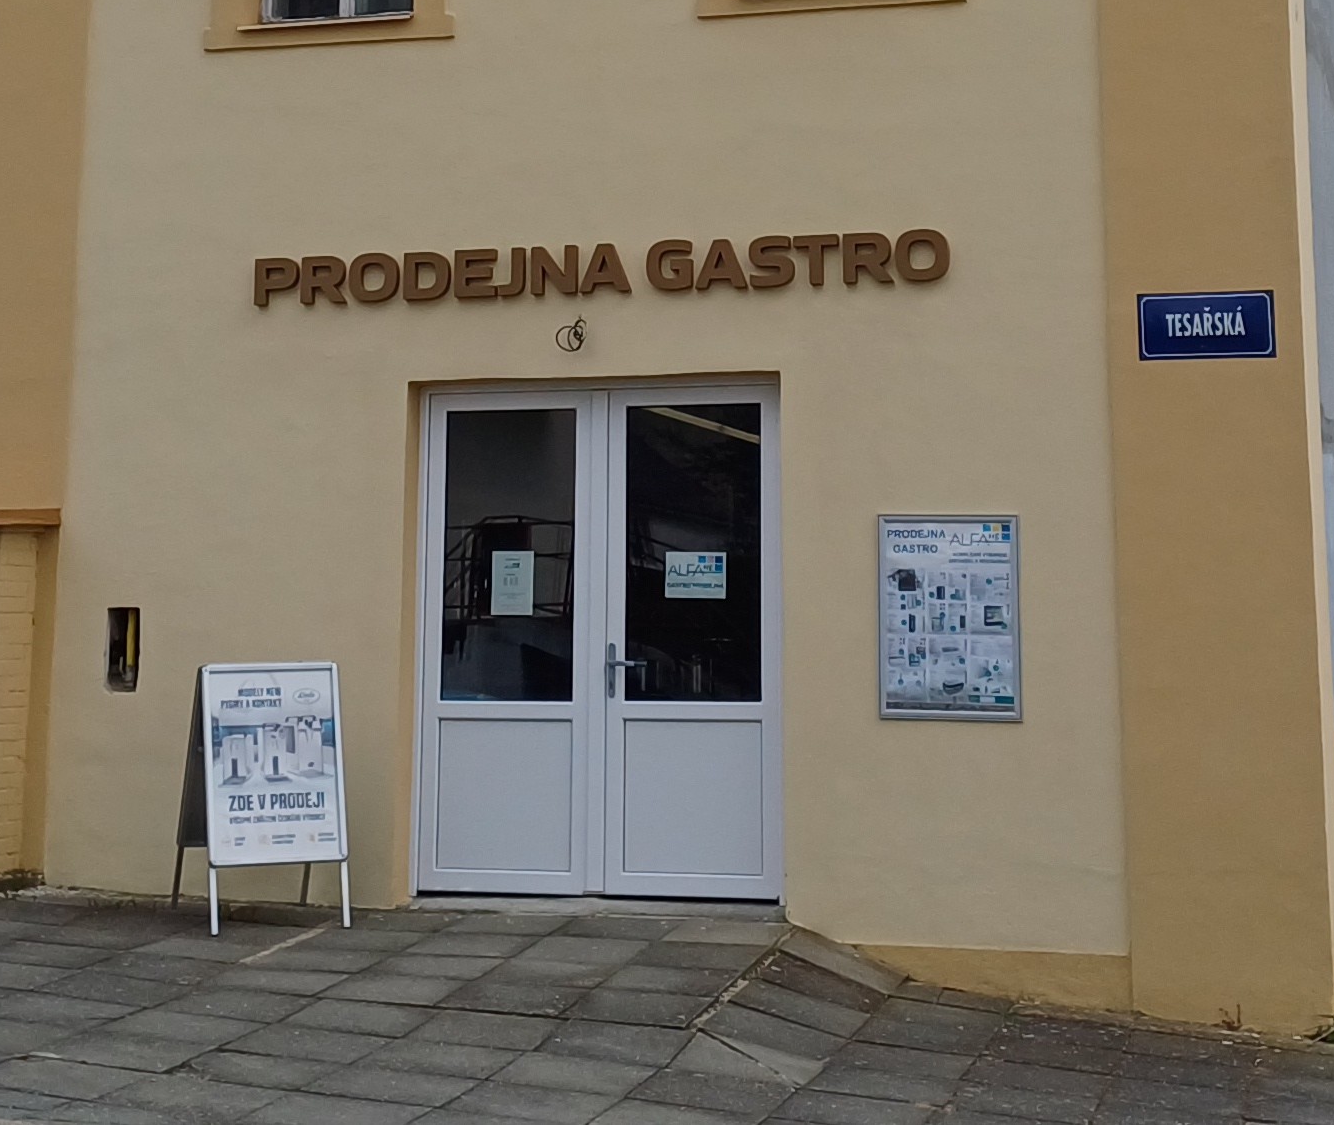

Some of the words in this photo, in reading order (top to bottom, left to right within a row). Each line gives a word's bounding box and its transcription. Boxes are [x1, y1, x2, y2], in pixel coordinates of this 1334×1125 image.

[253, 243, 633, 307] PRODEJNA
[645, 228, 951, 292] GASTRO
[1165, 305, 1246, 337] TESAŘSKÁ
[886, 529, 946, 539] PRODEJNA
[949, 532, 989, 546] ALFA
[892, 544, 939, 554] GASTRO
[667, 563, 705, 577] ALFA
[228, 794, 254, 812] ZDE
[257, 794, 266, 810] V
